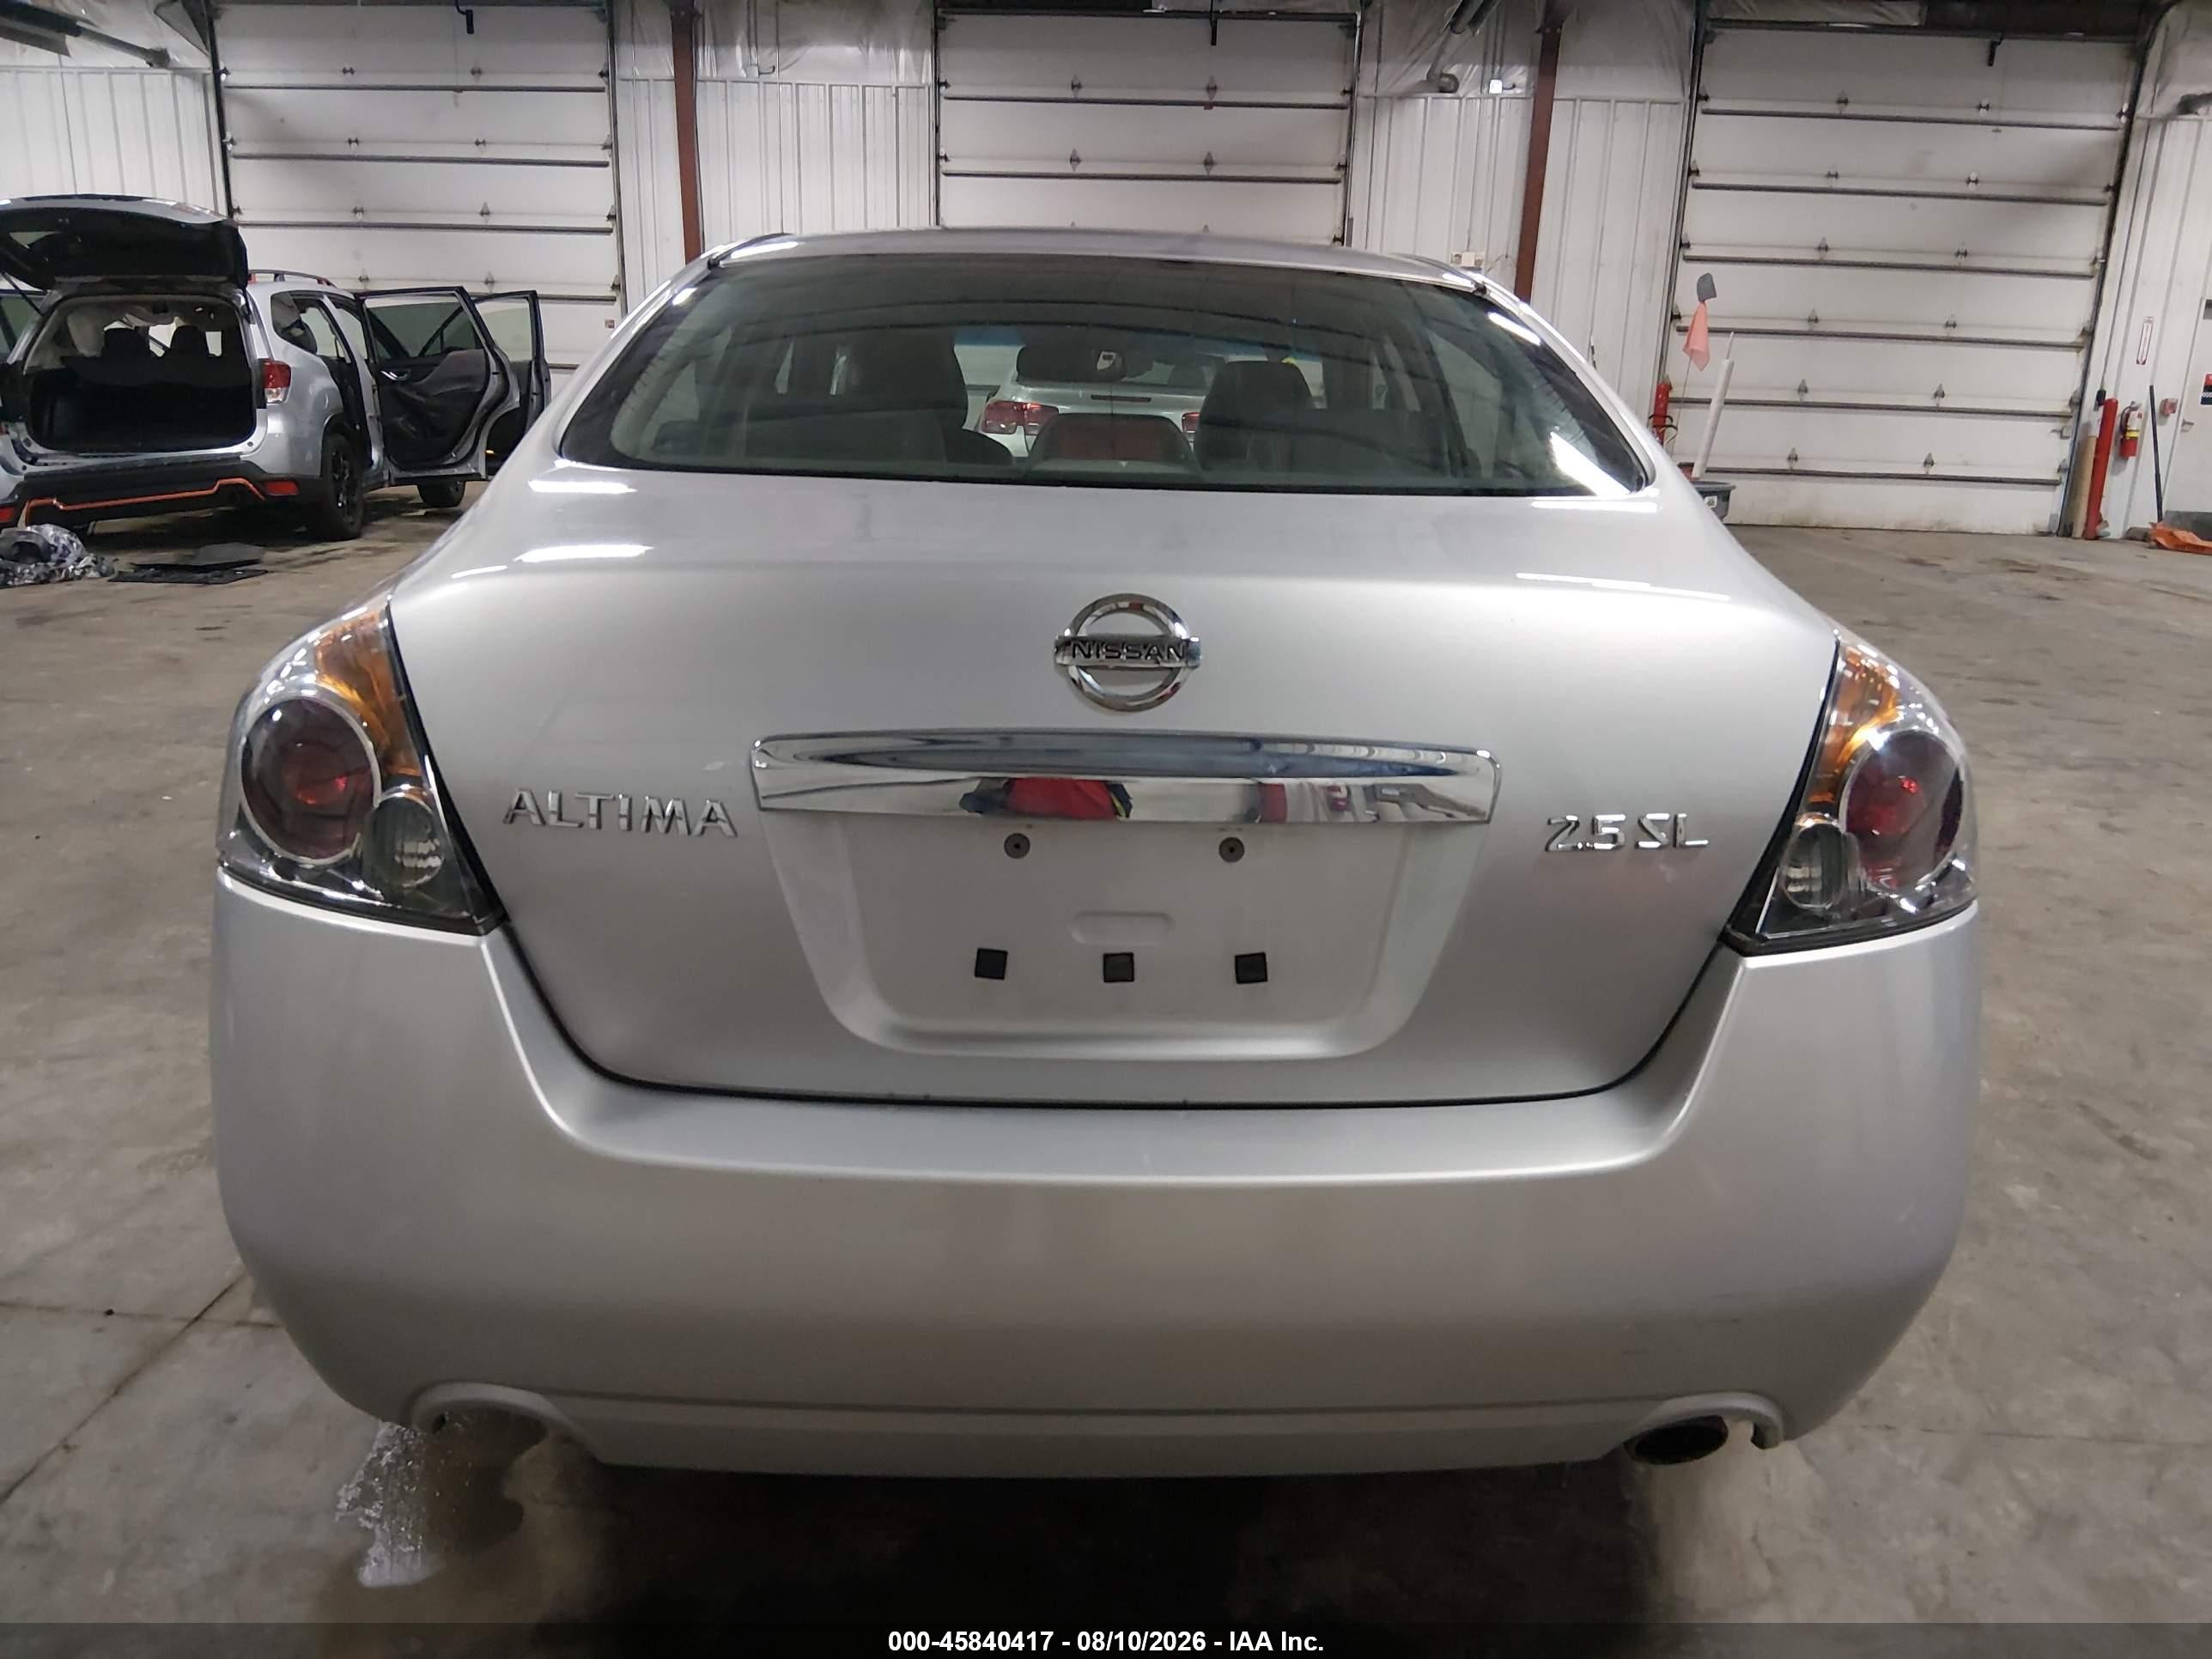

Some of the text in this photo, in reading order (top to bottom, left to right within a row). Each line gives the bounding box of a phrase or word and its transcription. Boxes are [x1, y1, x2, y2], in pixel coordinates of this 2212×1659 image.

[1072, 641, 1185, 661] NISSAN
[502, 787, 738, 838] ALTIMA
[1635, 813, 1709, 848] SL
